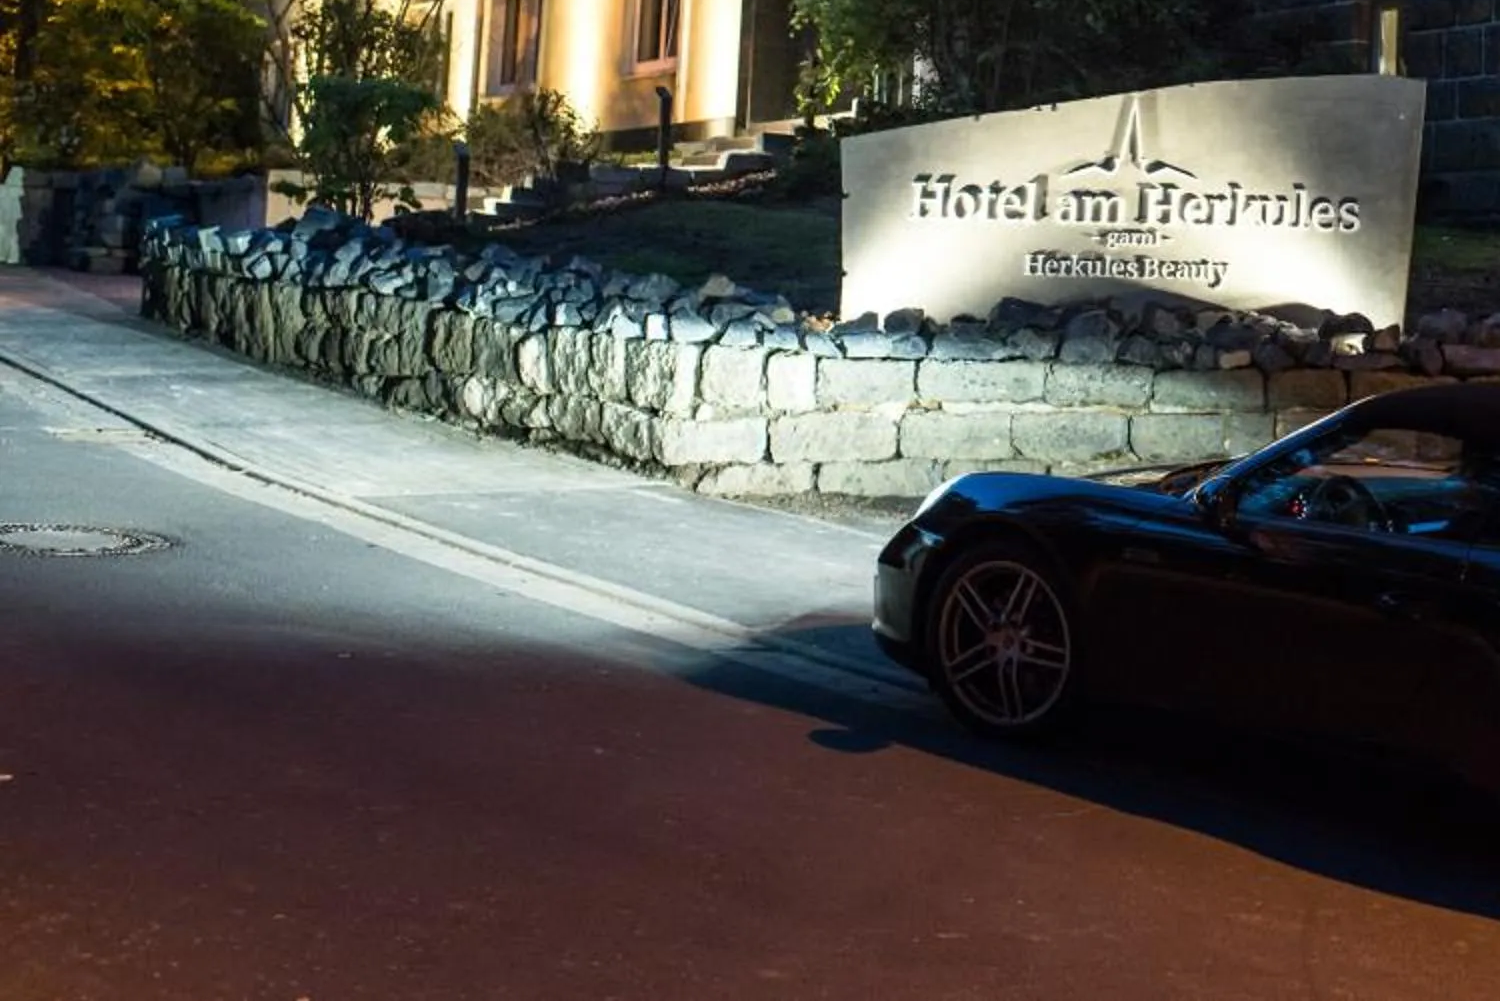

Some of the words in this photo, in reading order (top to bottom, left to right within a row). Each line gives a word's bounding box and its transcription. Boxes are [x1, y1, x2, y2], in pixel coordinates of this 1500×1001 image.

[909, 176, 1046, 225] Hotel
[1055, 190, 1127, 225] am
[1138, 183, 1362, 233] Herkules
[1023, 253, 1141, 280] Herkules
[1142, 257, 1232, 289] Beauty
